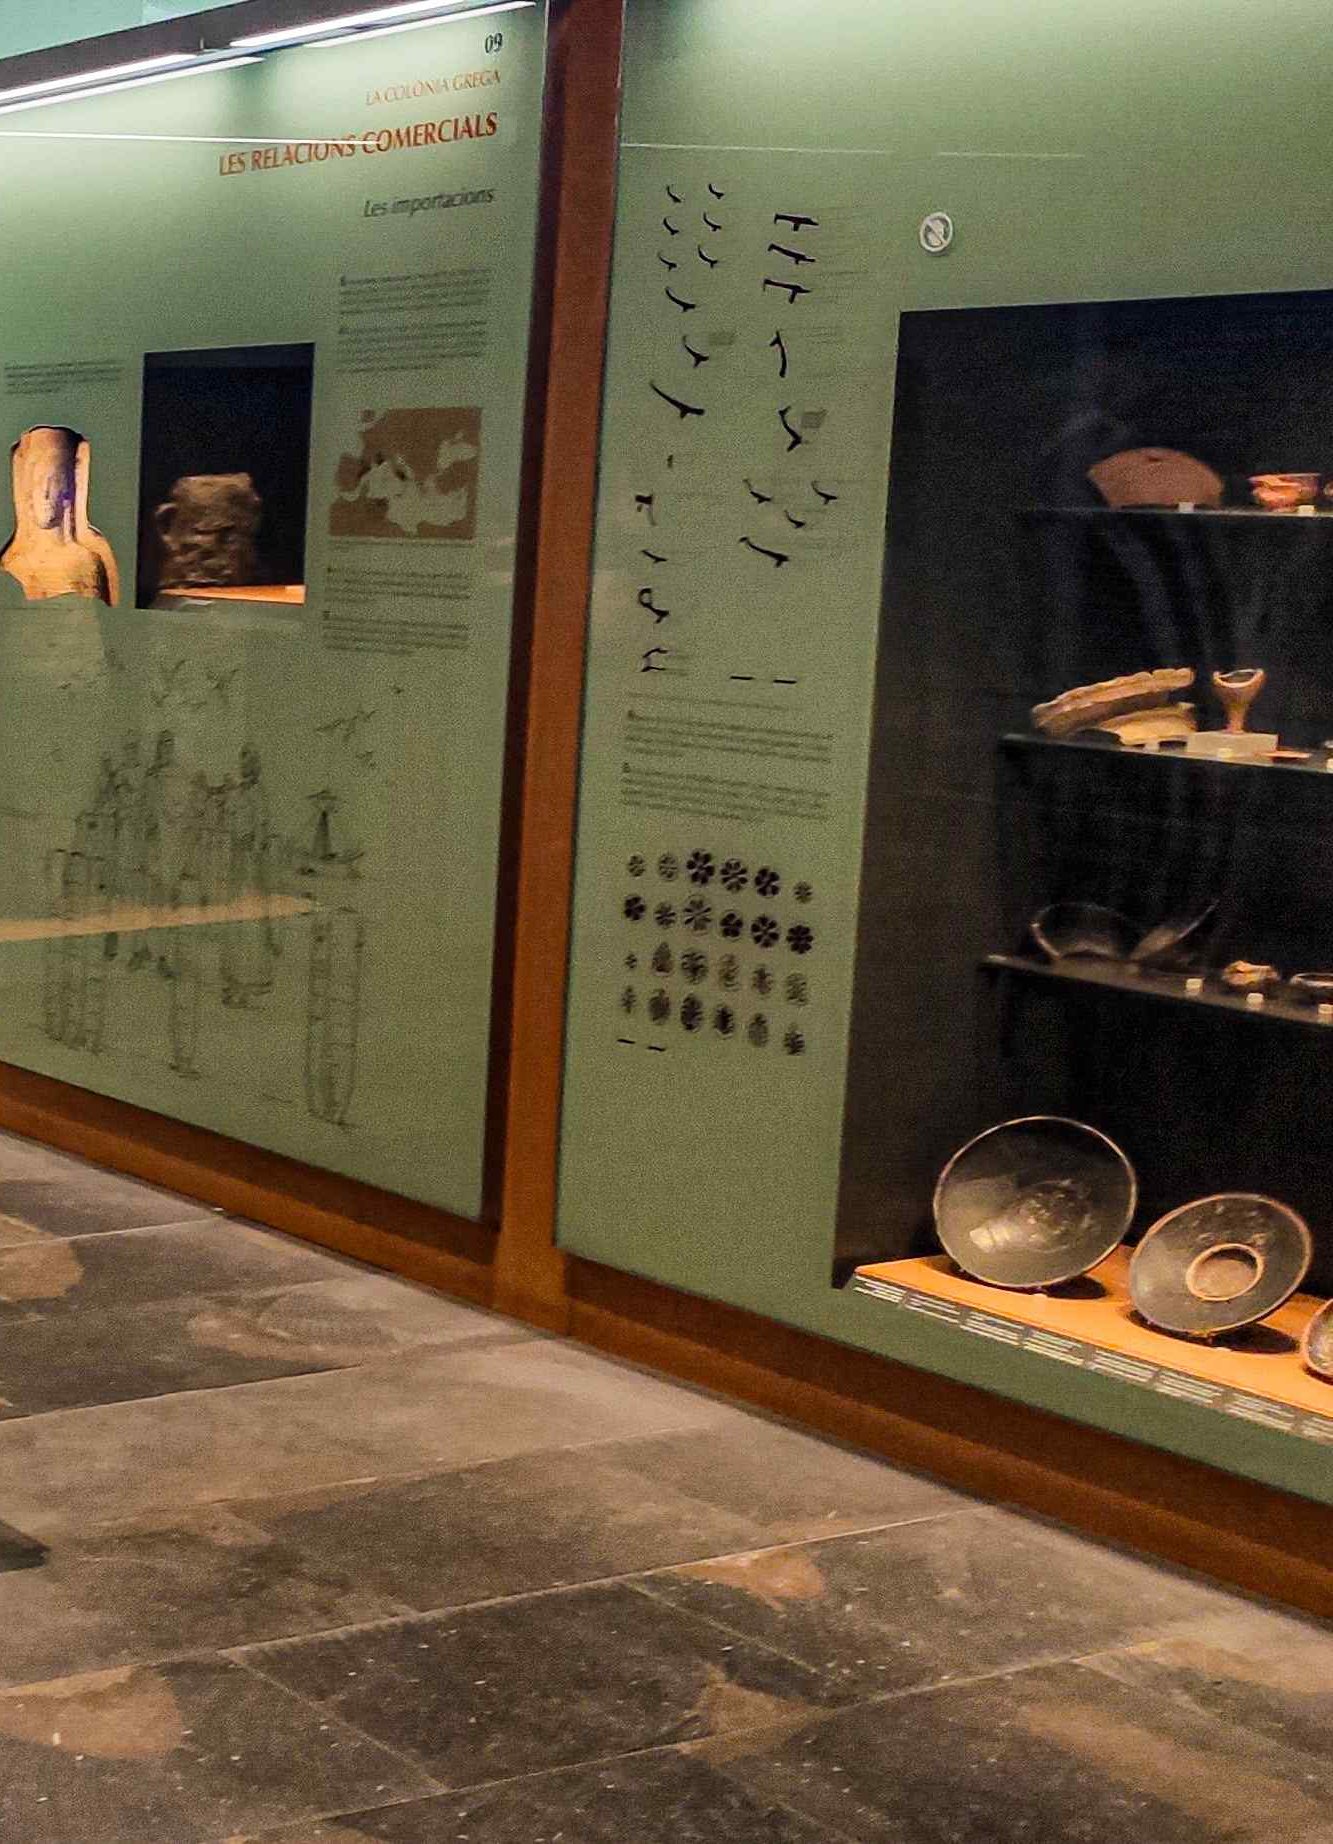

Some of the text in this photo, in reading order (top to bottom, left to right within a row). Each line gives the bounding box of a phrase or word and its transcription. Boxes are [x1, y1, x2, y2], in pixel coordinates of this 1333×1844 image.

[484, 32, 504, 54] 09
[453, 68, 502, 91] GREGA
[219, 111, 499, 177] LES RELACIONS COMERCIALS
[363, 186, 496, 218] Les importacions
